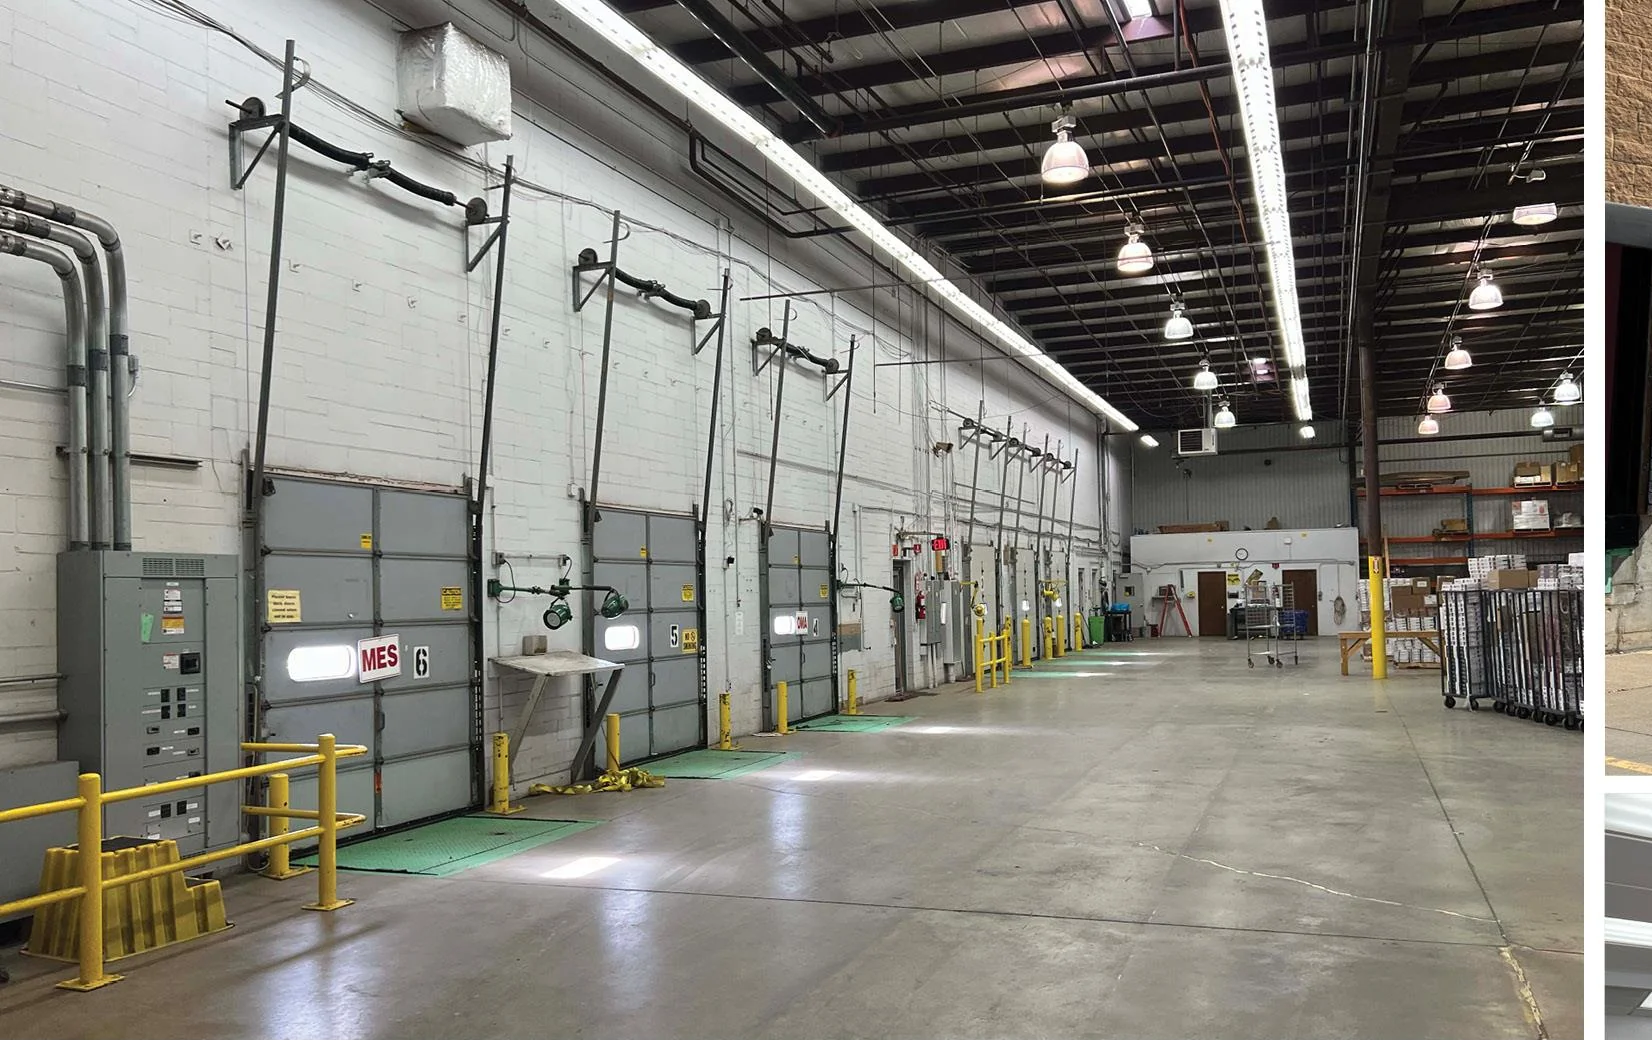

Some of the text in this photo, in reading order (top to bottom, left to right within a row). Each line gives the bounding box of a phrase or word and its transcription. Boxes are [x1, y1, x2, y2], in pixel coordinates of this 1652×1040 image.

[671, 625, 678, 646] 5
[361, 643, 398, 672] MES
[415, 648, 428, 676] 6
